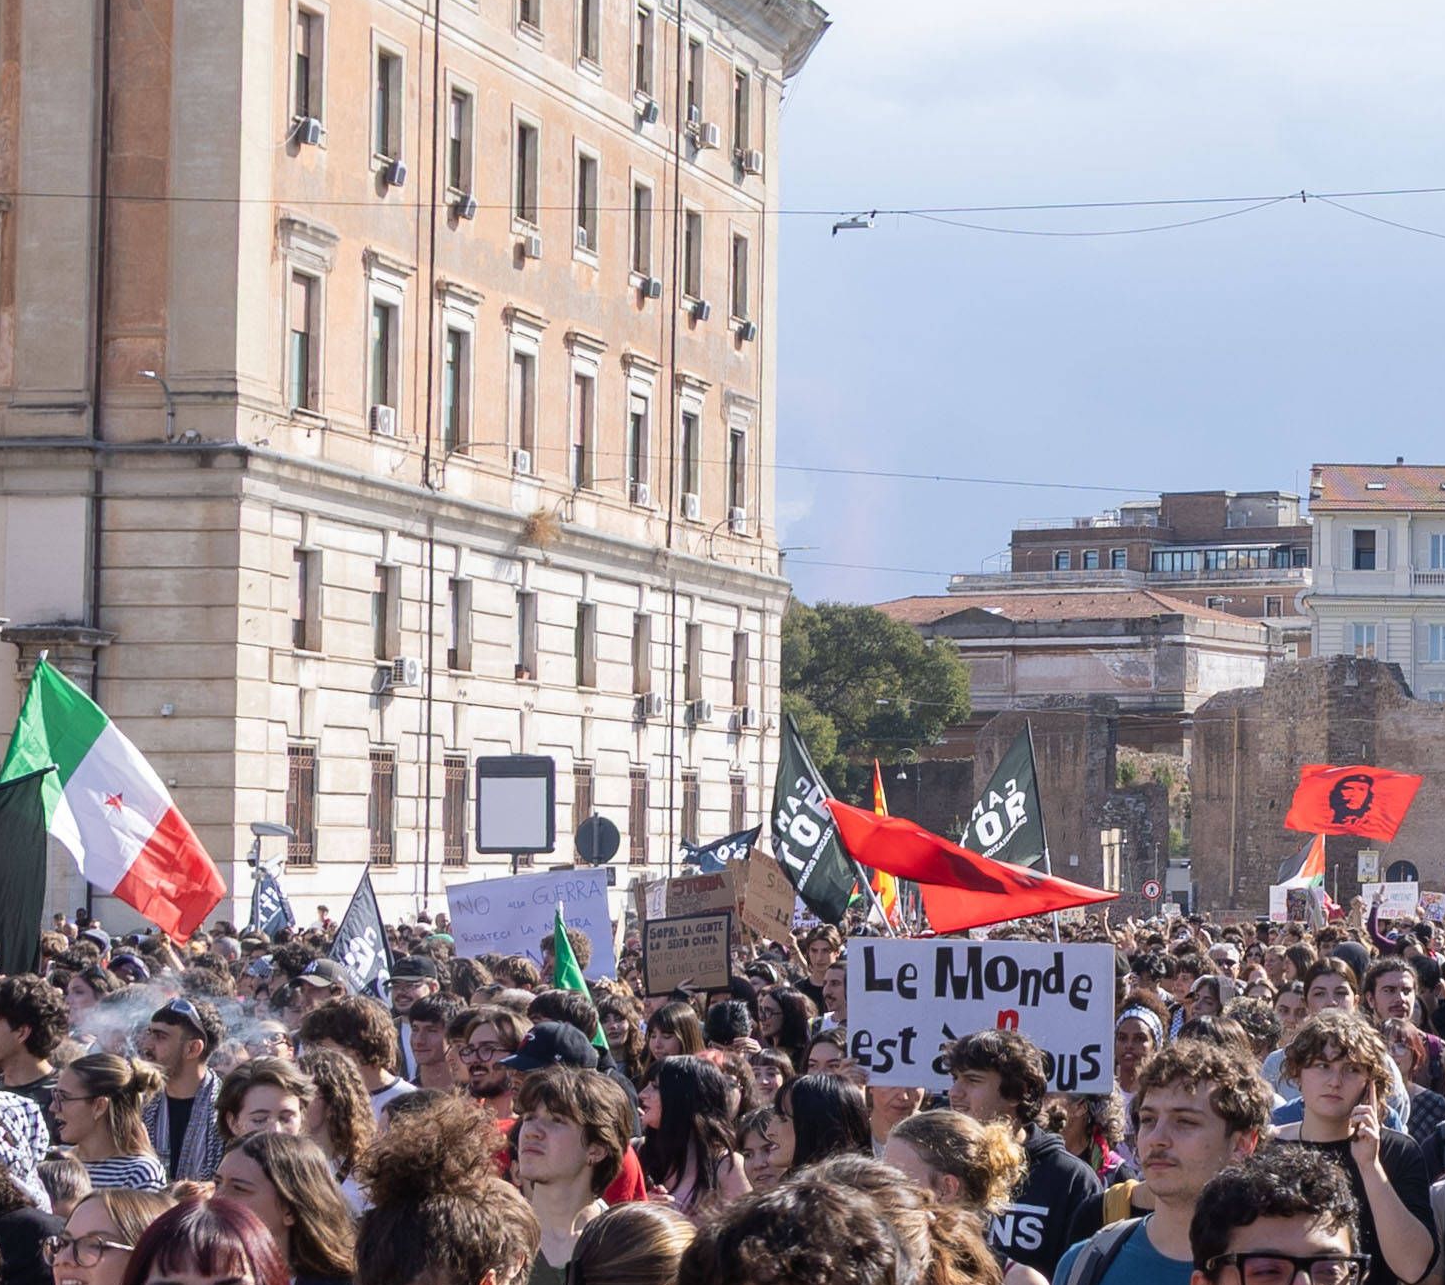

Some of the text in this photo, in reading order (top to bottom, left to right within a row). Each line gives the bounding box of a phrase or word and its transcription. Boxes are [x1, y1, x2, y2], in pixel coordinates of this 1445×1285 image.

[456, 894, 490, 915] NO
[532, 879, 602, 905] GUERRA
[544, 917, 592, 931] NTRA
[863, 946, 1093, 1012] Le Monde
[851, 1026, 918, 1073] est
